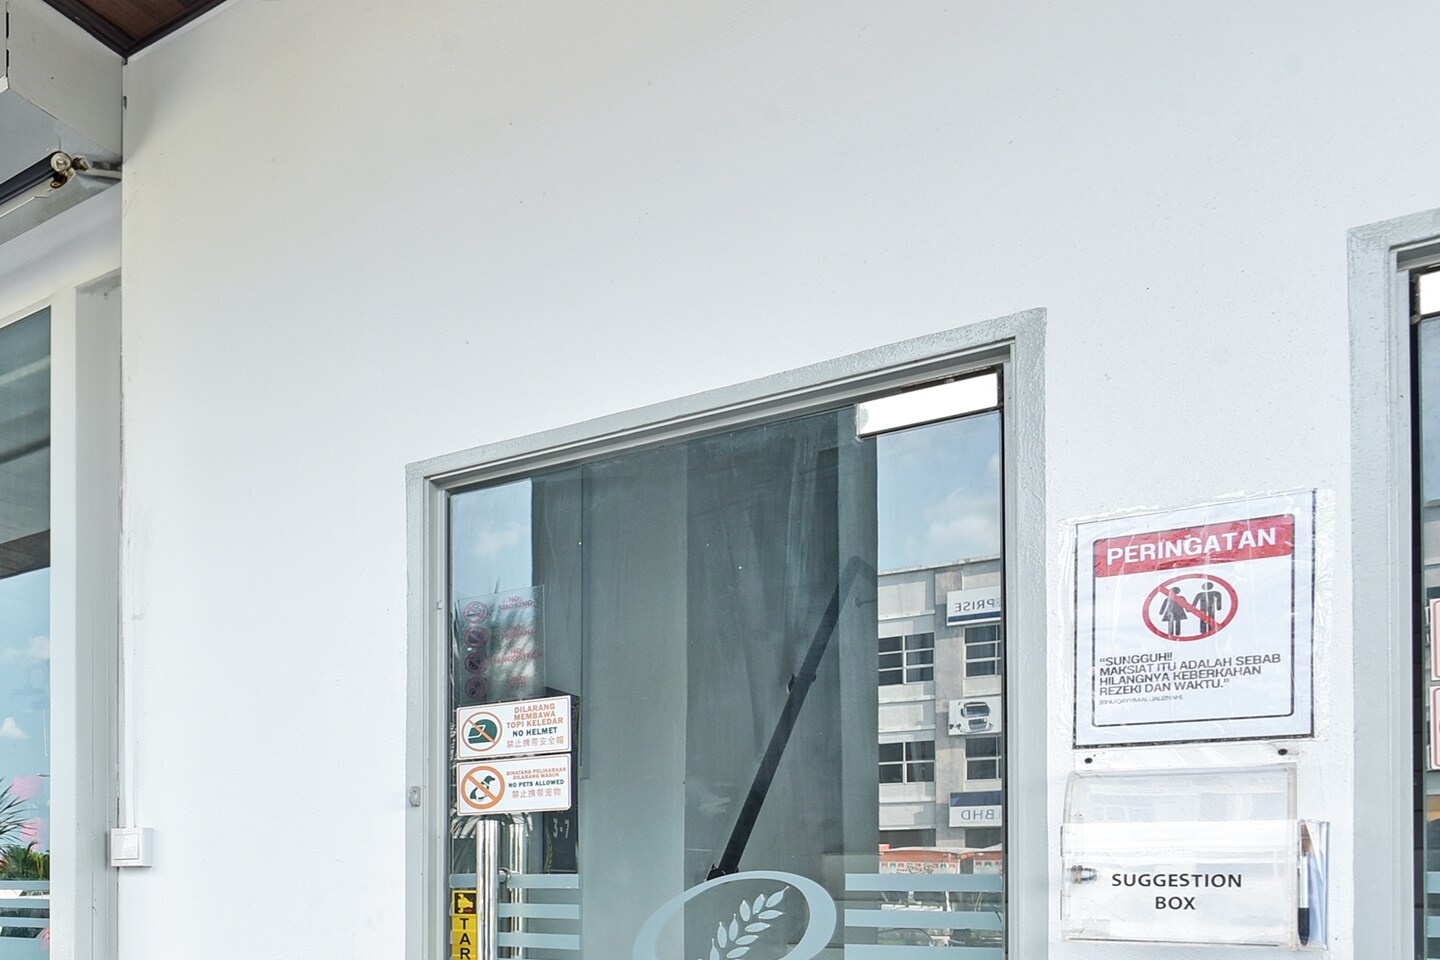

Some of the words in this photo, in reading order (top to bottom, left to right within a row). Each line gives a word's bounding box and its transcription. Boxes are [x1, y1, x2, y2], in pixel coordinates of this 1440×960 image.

[1106, 527, 1276, 566] PERINGATAN
[1099, 663, 1152, 676] MAKSIAT
[1157, 660, 1176, 672] ITU
[1179, 657, 1232, 670] ADALAH
[1235, 653, 1281, 666] SEBAB
[1099, 673, 1170, 686] HILANGNYA
[1173, 666, 1262, 681] KEBERKAHAN
[1099, 684, 1142, 696] REZEKI
[1144, 682, 1171, 693] DAN
[514, 703, 556, 713] DILARANG
[514, 710, 556, 721] MEMBAWA
[526, 717, 563, 727] KELEDAR
[526, 726, 557, 736] HELMET
[1111, 873, 1243, 888] SUGGESTION
[1154, 896, 1196, 910] BOX
